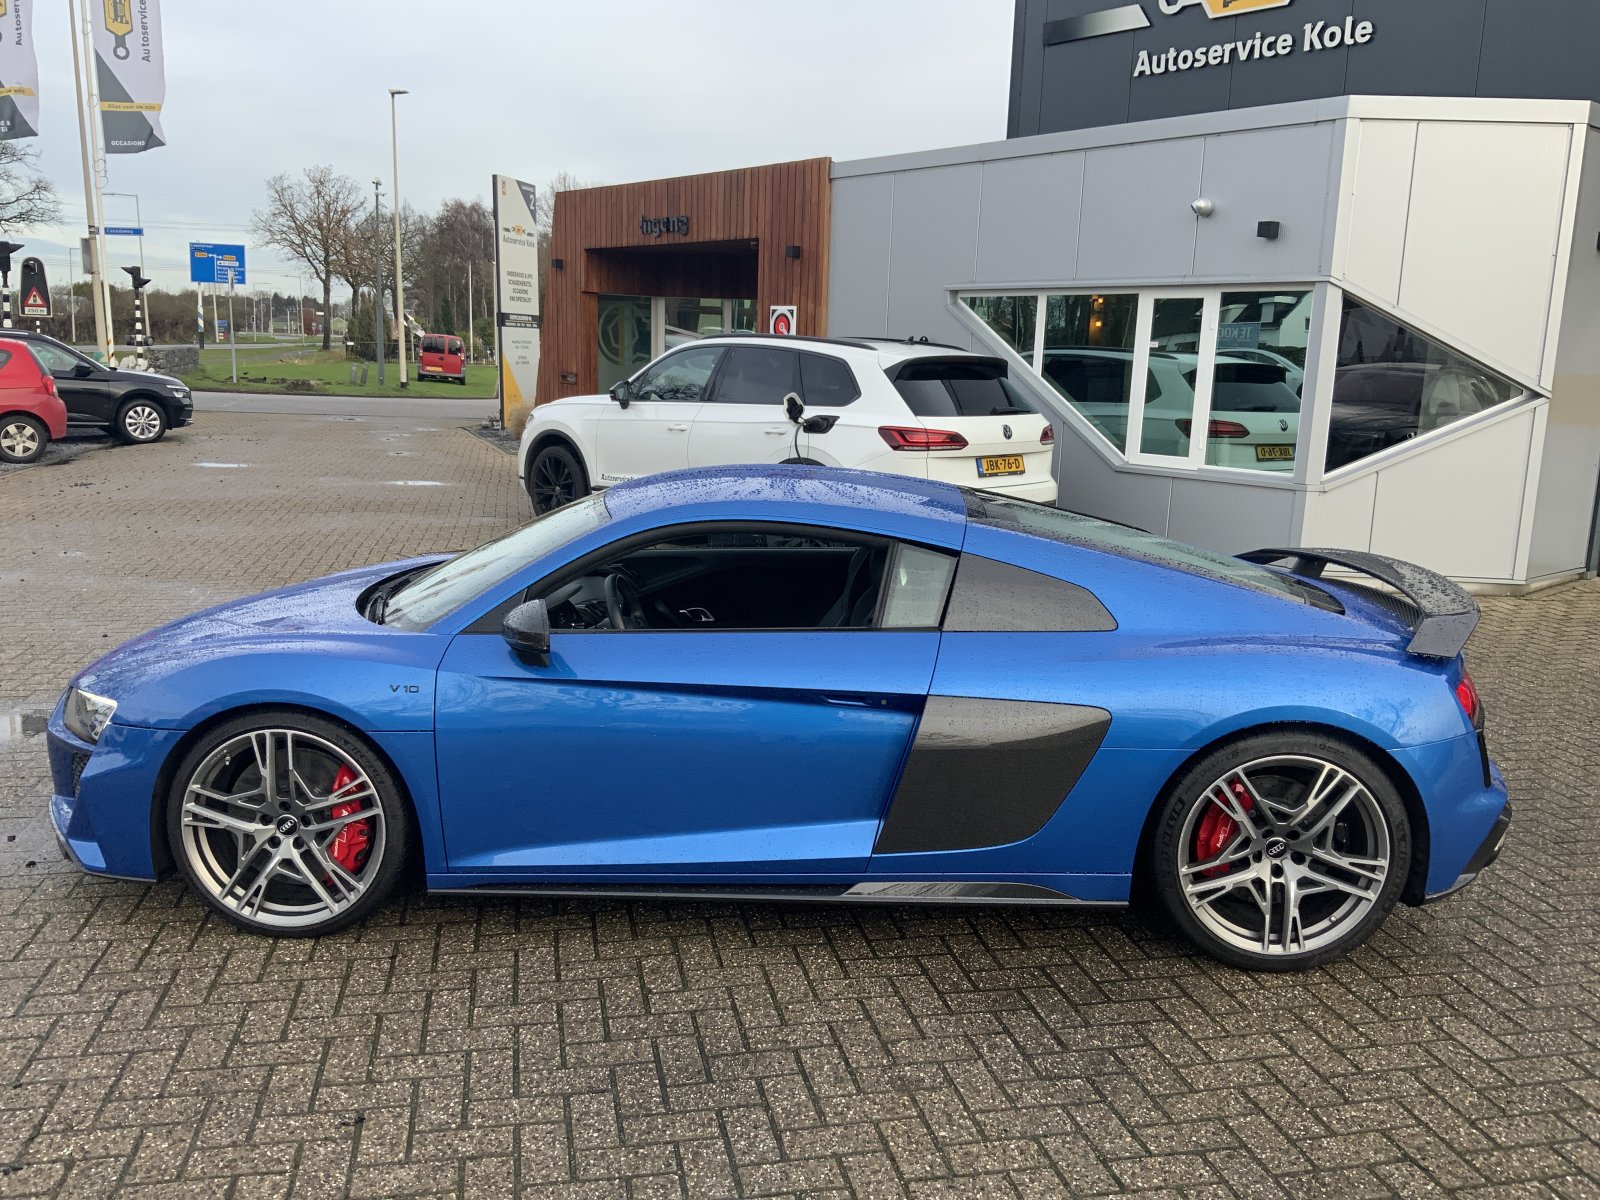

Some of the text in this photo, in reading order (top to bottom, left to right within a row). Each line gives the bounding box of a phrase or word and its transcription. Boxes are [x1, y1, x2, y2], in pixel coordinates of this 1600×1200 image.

[138, 0, 151, 63] Autoservice
[1133, 15, 1373, 77] Autoservice Kole
[529, 194, 535, 210] 2
[503, 235, 535, 248] Autoservice Kole
[985, 458, 1020, 471] JBK-76-D
[1216, 833, 1225, 849] Audi
